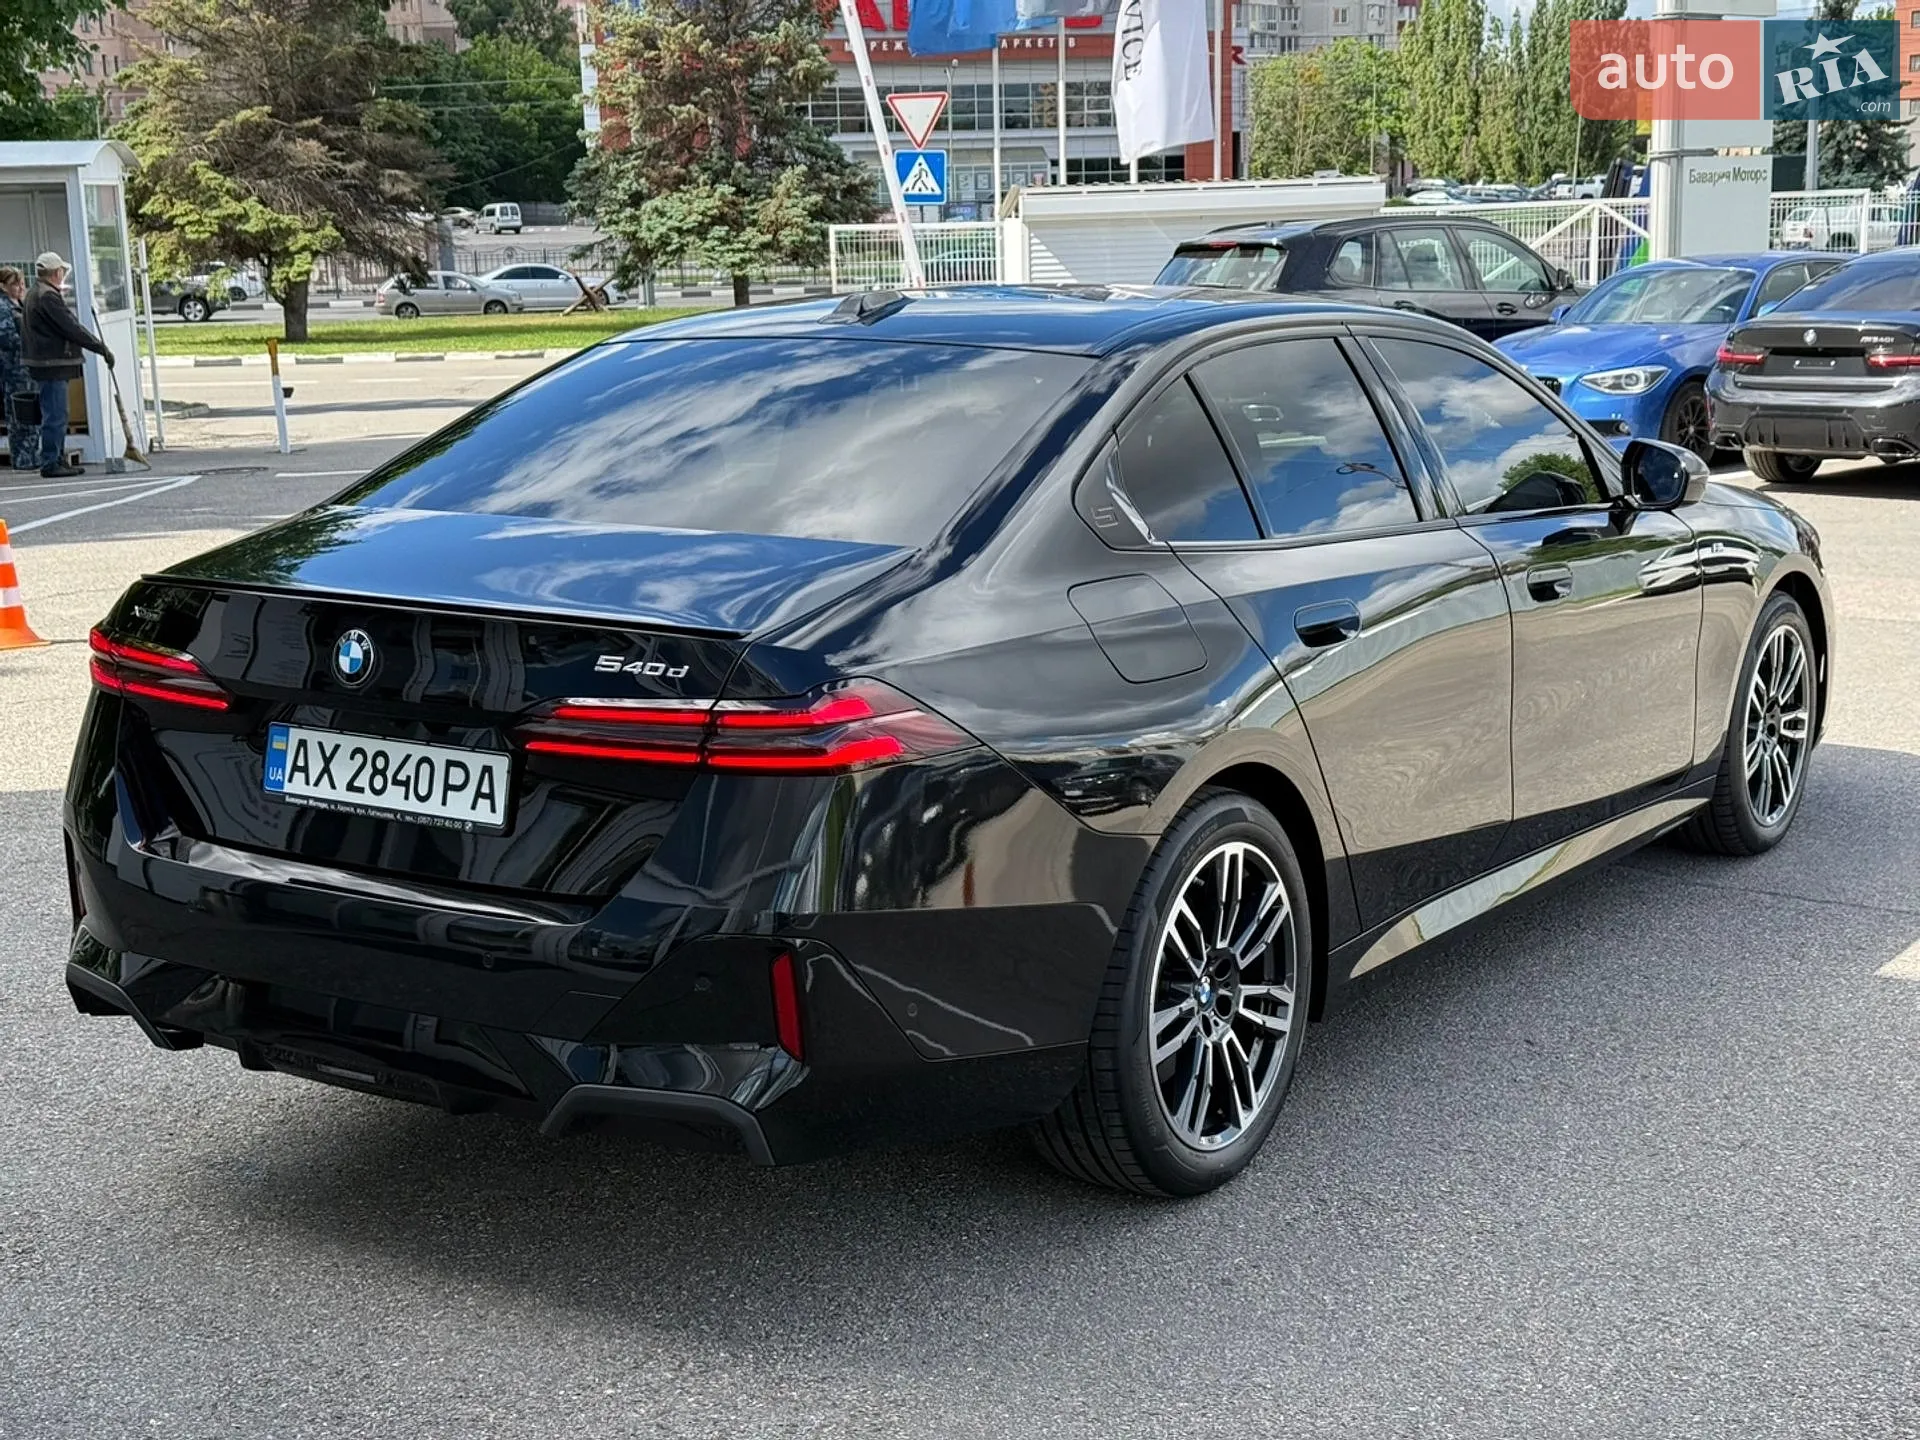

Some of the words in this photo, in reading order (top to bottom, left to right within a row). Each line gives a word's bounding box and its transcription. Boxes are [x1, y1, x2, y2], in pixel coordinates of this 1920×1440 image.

[1688, 168, 1731, 187] Бавария
[1732, 166, 1768, 184] Моторс
[593, 654, 690, 678] 540d
[268, 767, 283, 781] UA
